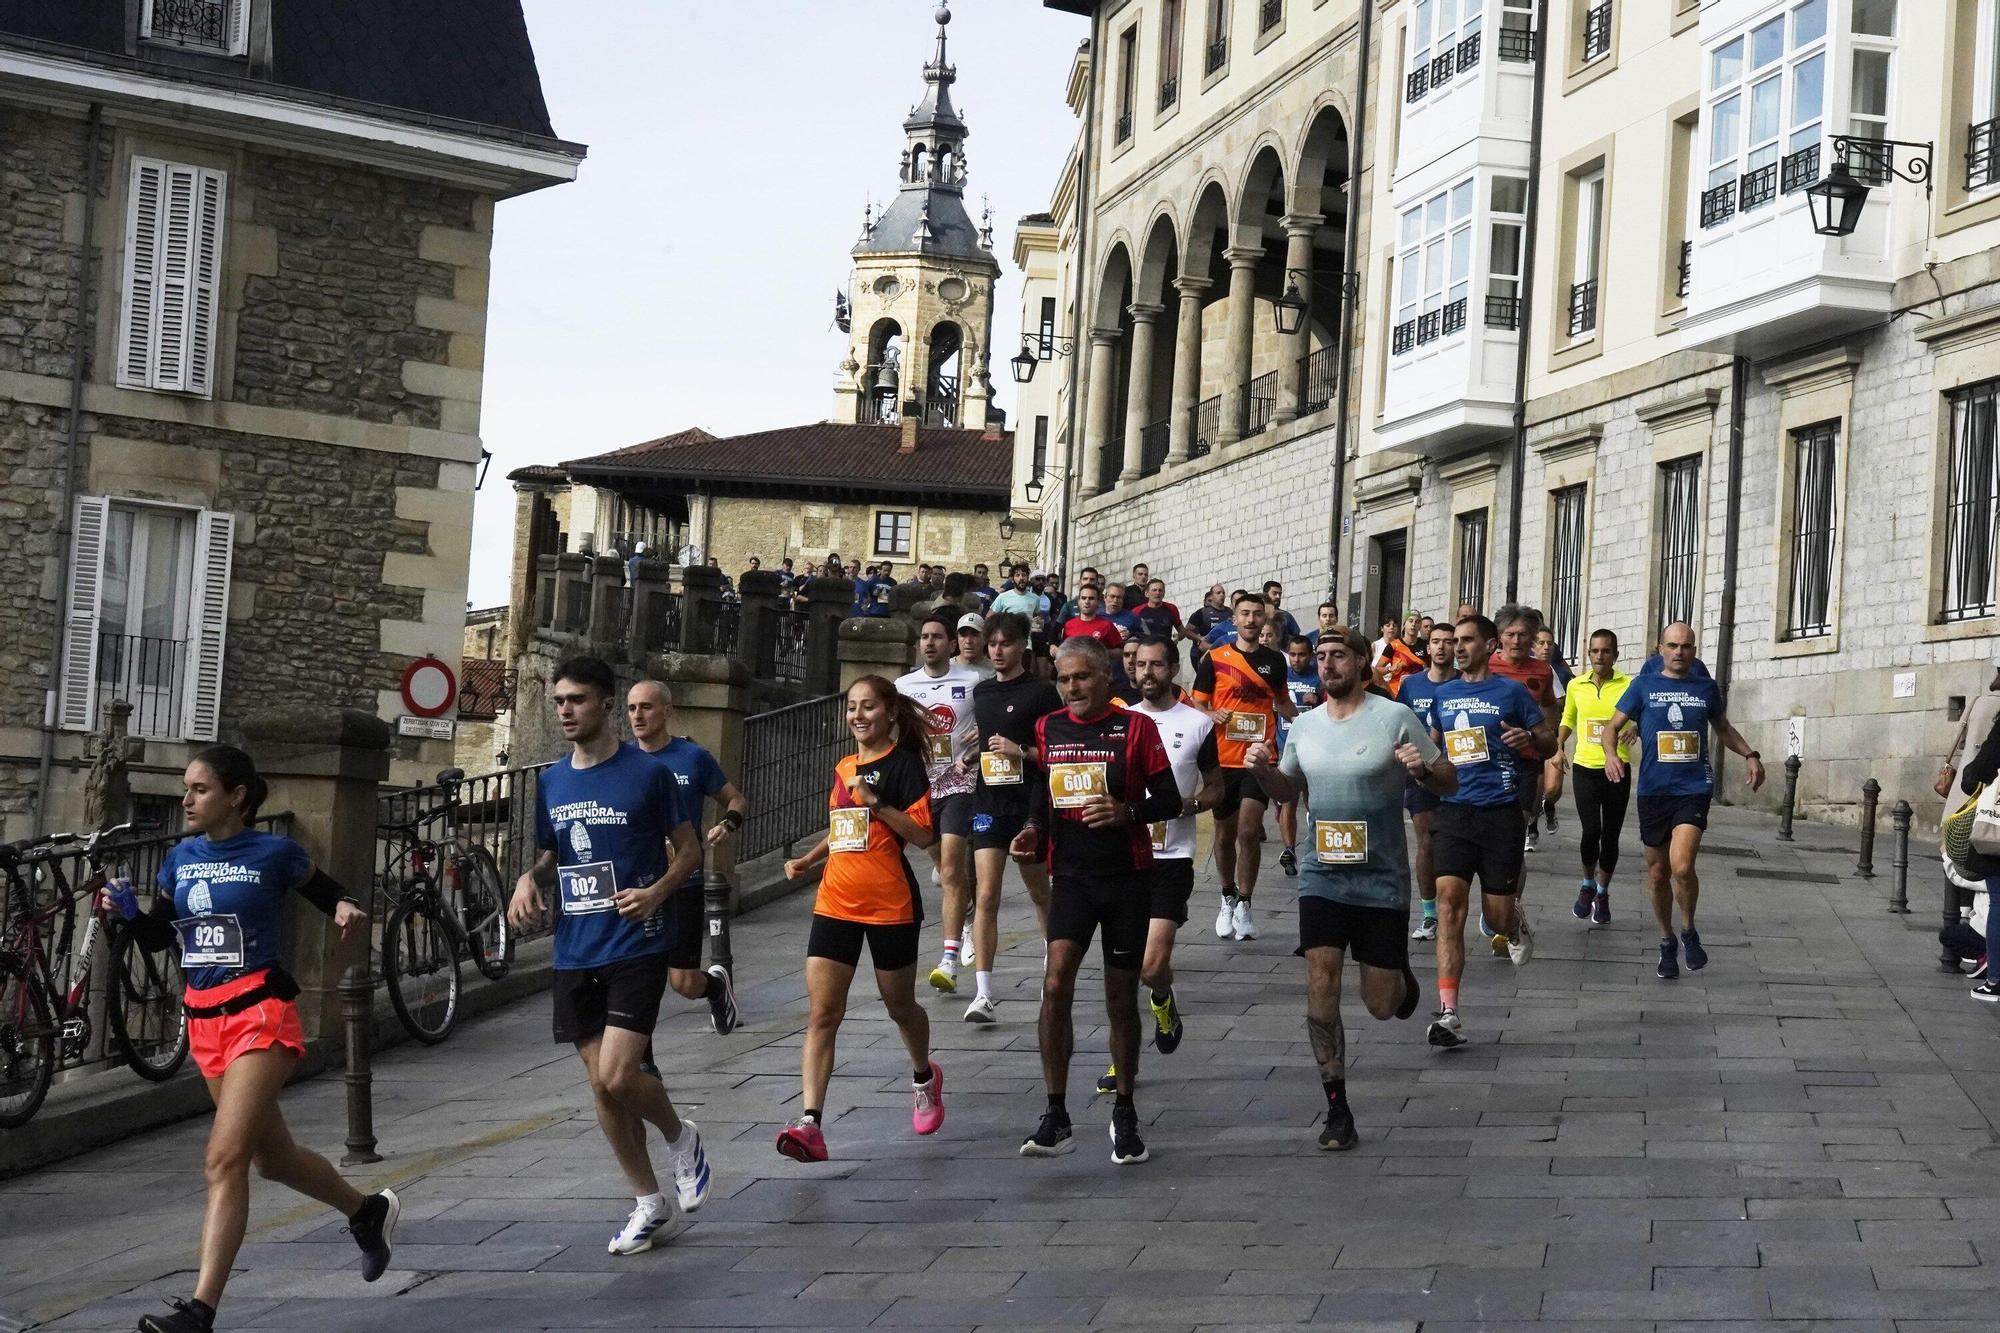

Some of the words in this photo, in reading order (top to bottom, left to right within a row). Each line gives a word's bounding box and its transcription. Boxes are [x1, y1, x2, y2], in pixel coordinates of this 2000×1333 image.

[1448, 702, 1491, 711] ALMENDRA
[1469, 708, 1500, 716] KONKISTA
[1236, 719, 1256, 731] 580
[1454, 736, 1475, 752] 645
[1673, 739, 1686, 751] 91
[990, 759, 1010, 773] 258
[1063, 774, 1092, 792] 600
[555, 801, 598, 814] CONQUISTA
[557, 807, 614, 823] ALMENDRA
[585, 816, 628, 826] KONKISTA
[1325, 831, 1353, 848] 564
[179, 865, 247, 881] ALMENDRA
[182, 862, 230, 872] CONQUISTA
[211, 874, 261, 885] KONKISTA
[570, 876, 599, 897] 802
[195, 925, 225, 947] 926
